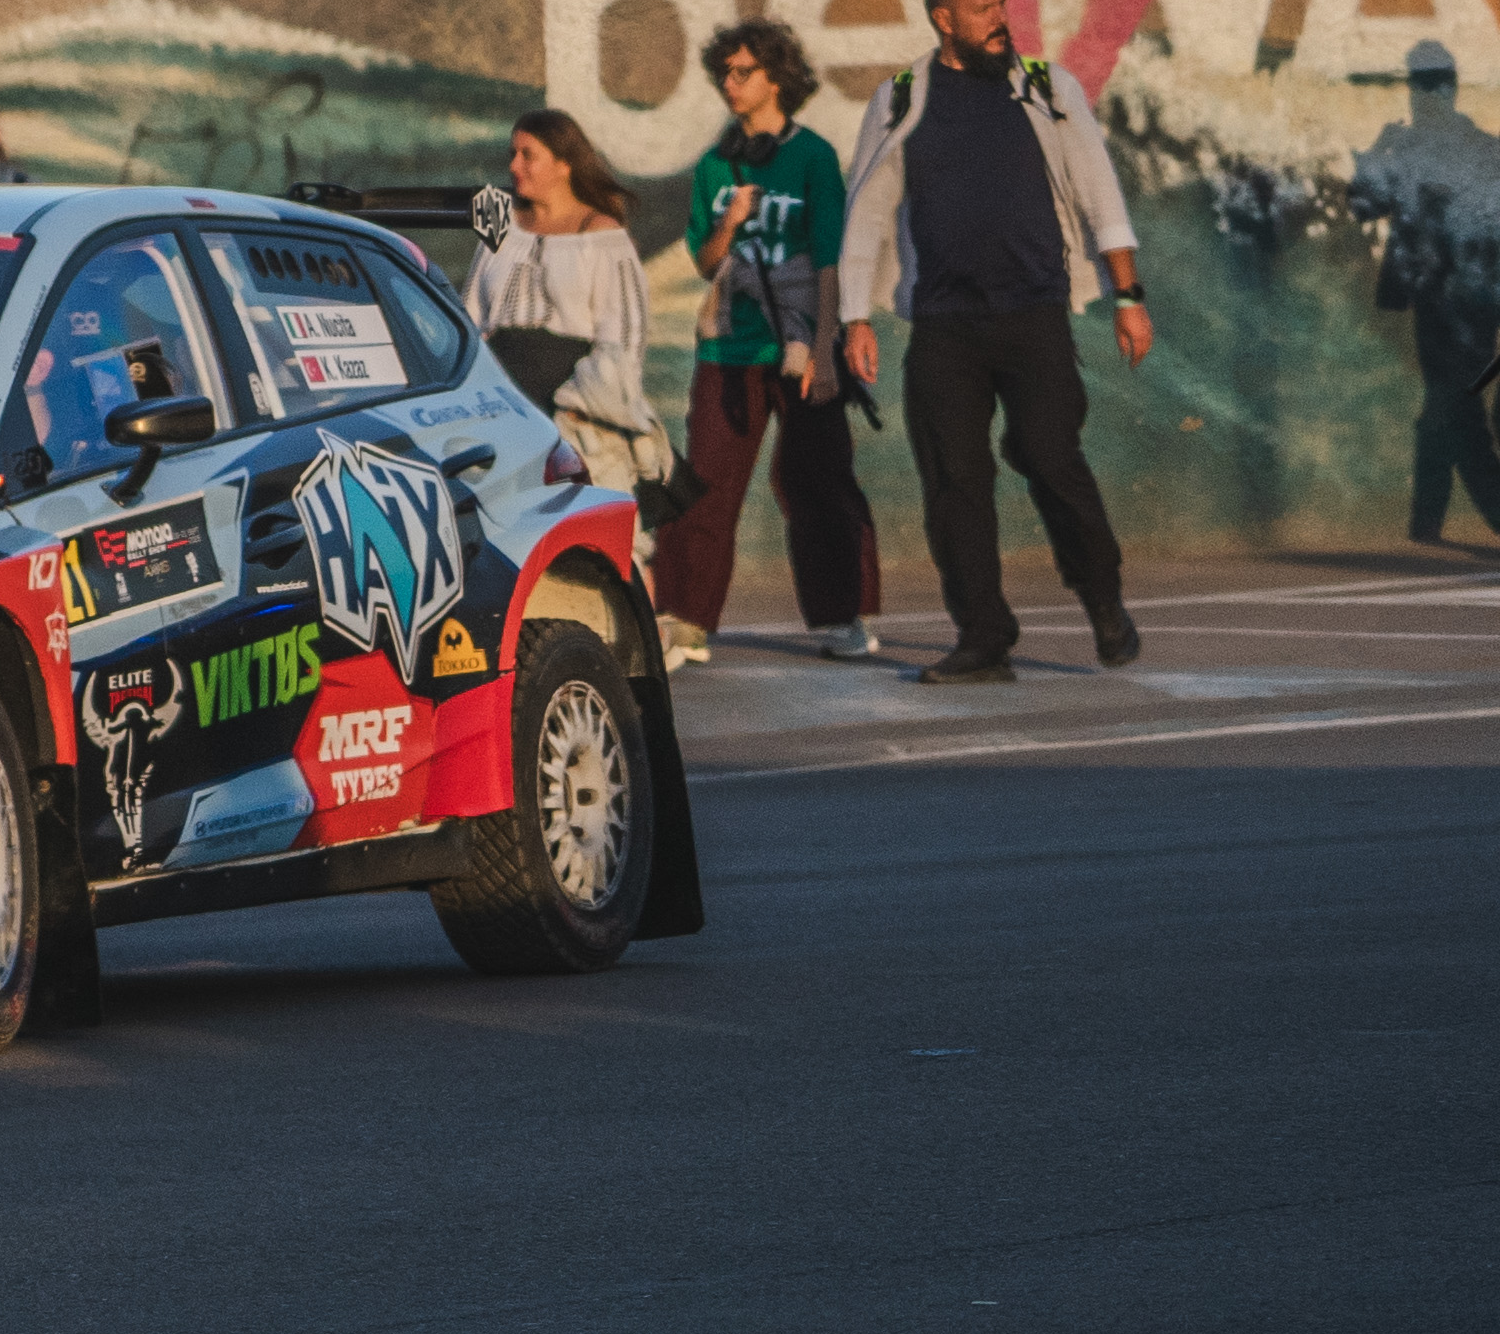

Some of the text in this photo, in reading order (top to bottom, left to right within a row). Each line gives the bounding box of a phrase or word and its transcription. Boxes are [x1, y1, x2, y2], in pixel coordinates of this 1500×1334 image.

[338, 357, 371, 381] Kazaz
[108, 667, 153, 690] ELITE
[437, 657, 480, 676] TOKKO
[317, 704, 412, 763] MRF
[331, 763, 403, 806] TYRES
